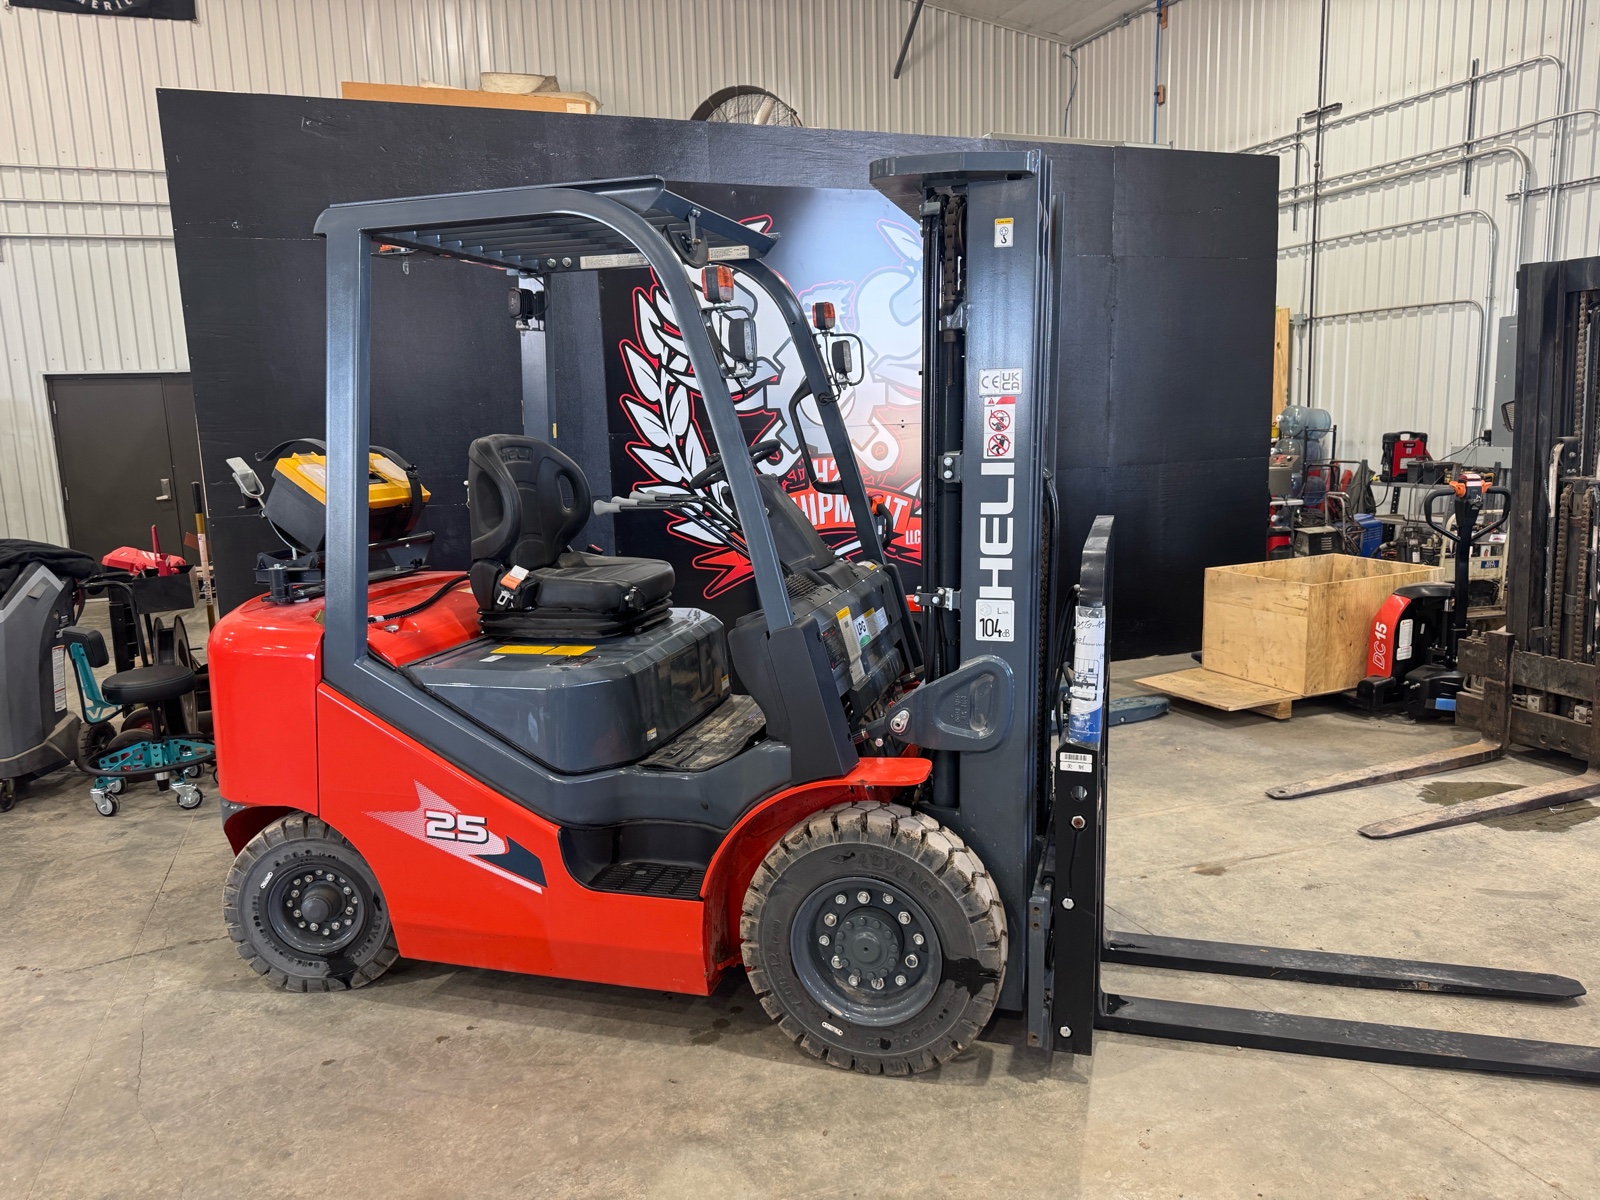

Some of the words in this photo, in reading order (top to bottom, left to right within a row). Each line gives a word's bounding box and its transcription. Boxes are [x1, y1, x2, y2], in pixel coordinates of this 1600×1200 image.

[1002, 372, 1020, 381] UK
[1002, 382, 1020, 390] CA
[905, 528, 921, 546] LLC
[979, 462, 1015, 599] HELI
[856, 620, 867, 636] LPG
[979, 618, 1003, 638] 104
[425, 809, 488, 844] 25
